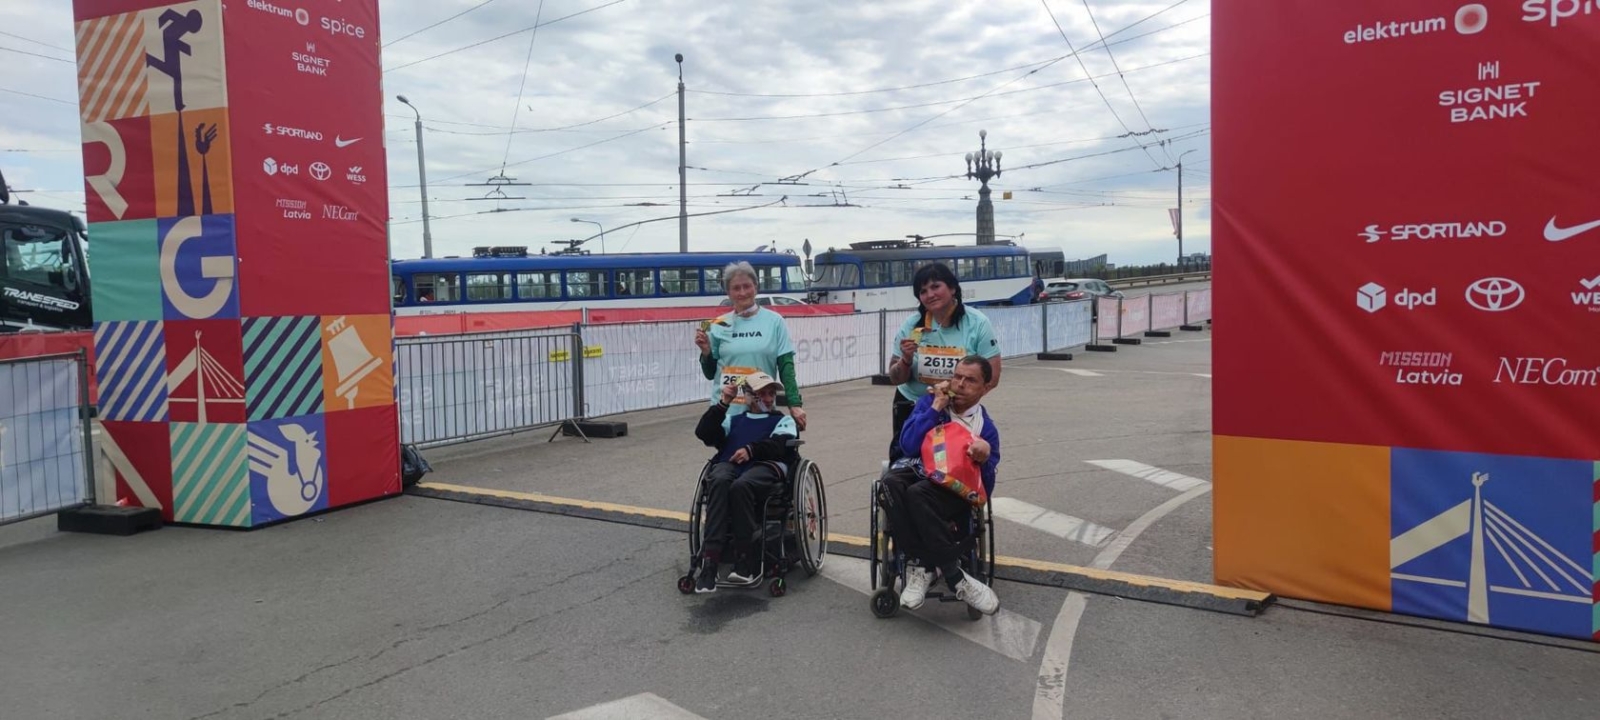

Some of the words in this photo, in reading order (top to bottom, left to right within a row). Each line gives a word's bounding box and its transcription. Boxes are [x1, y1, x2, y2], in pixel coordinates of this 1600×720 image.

[247, 0, 293, 19] elektrum
[321, 16, 365, 38] spice
[1343, 17, 1446, 44] elektrum
[291, 52, 331, 67] SIGNET
[297, 63, 327, 77] BANK
[1438, 81, 1541, 107] SIGNET
[1450, 101, 1528, 123] BANK
[276, 125, 324, 141] SPORTLAND
[280, 162, 299, 176] dpd
[346, 172, 366, 183] WESS
[275, 197, 307, 209] MISSION
[283, 209, 312, 220] Latvia
[1390, 220, 1507, 241] SPORTLAND
[1393, 287, 1437, 311] dpd
[923, 356, 960, 369] 26131
[1379, 350, 1453, 367] MISSION
[929, 367, 954, 375] VELGA
[1396, 368, 1463, 387] Latvia
